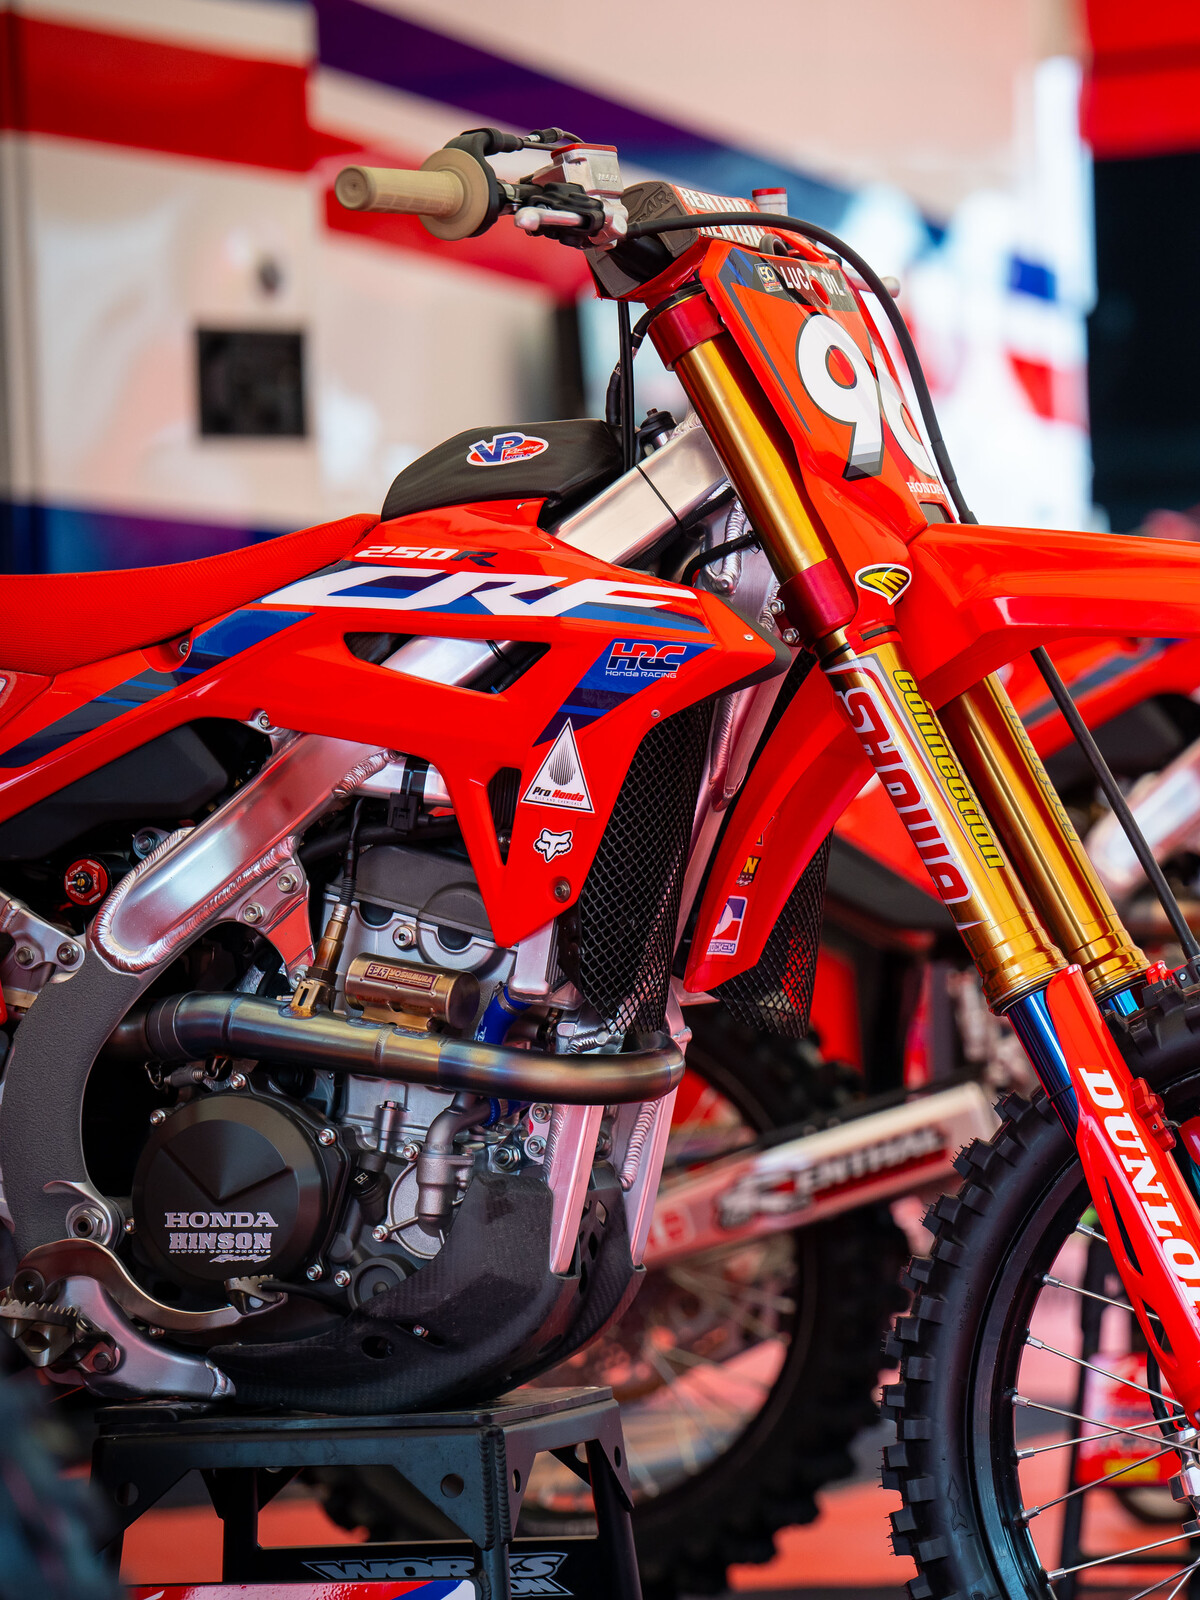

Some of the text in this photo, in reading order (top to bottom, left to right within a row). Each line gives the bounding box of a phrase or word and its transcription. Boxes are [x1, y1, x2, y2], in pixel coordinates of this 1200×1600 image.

[820, 272, 846, 297] OIL
[474, 435, 524, 463] VP
[355, 546, 498, 567] 250R
[261, 566, 698, 617] CRF
[606, 642, 687, 672] HRC
[641, 671, 677, 679] RACING
[532, 786, 585, 802] Pro Honda
[388, 969, 434, 984] YOSHIMURA
[164, 1211, 279, 1229] HONDA
[169, 1232, 273, 1250] HINSON
